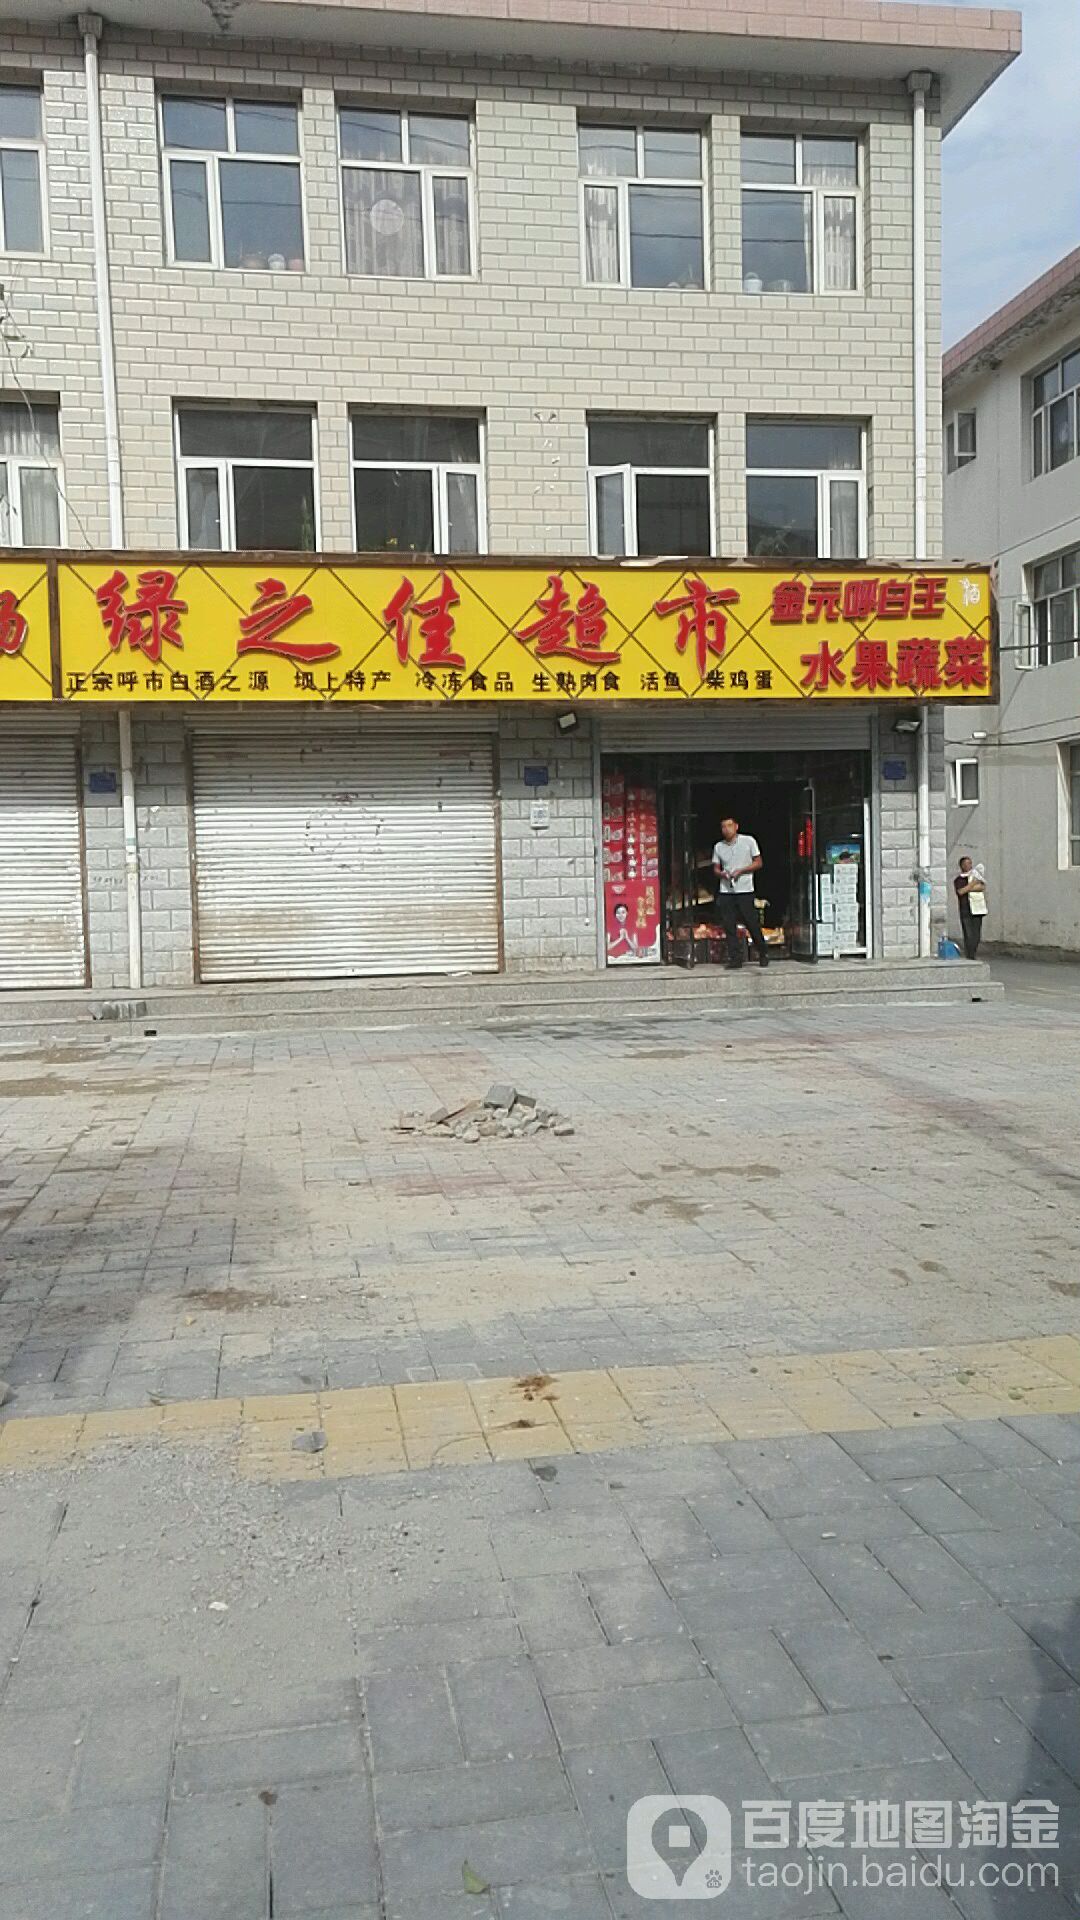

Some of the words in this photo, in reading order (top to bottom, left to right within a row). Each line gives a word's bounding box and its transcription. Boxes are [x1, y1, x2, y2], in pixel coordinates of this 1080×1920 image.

[95, 570, 741, 678] 绿之佳超市
[770, 578, 949, 624] 金元呼白王
[66, 670, 269, 693] 正宗呼市白酒之源
[294, 670, 392, 692] 坝上特产
[415, 669, 514, 692] 冷冻食品
[532, 671, 620, 691] 生熟肉食
[640, 671, 680, 691] 活鱼
[706, 669, 773, 690] 柴鸡蛋
[800, 636, 989, 692] 水果蔬菜
